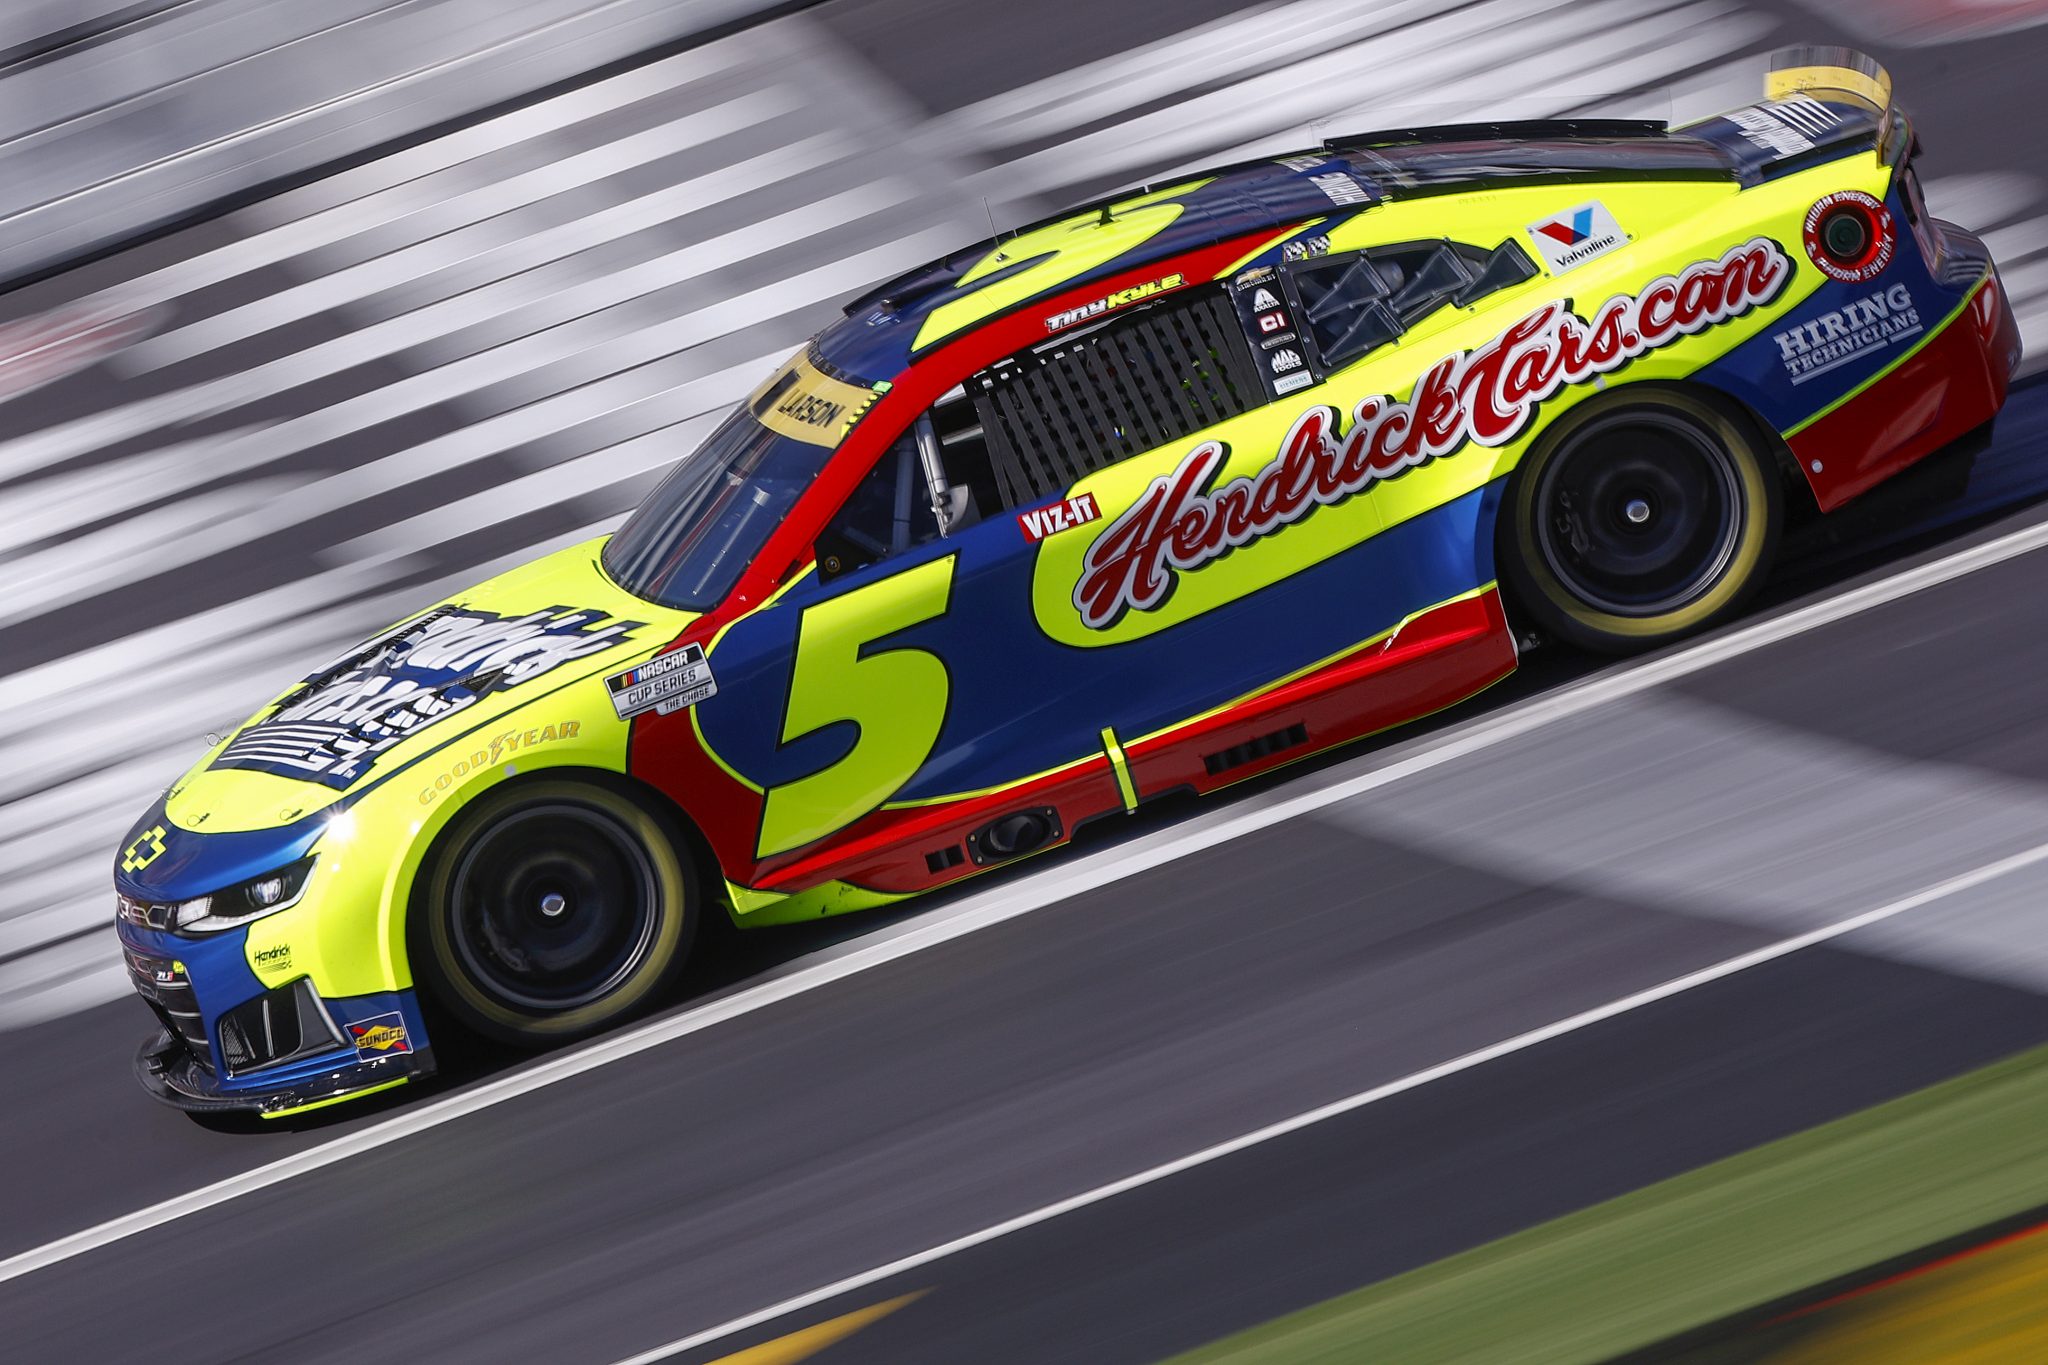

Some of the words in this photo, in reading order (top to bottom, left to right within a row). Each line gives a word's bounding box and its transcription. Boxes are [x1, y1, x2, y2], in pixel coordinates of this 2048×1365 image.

[1556, 234, 1617, 269] Valvoline
[1860, 231, 1894, 280] ENERGY
[1773, 282, 1913, 362] HIRING
[1784, 306, 1921, 377] TECHNICIANS
[1271, 348, 1301, 369] MAC
[1273, 359, 1303, 374] TOOLS
[1073, 235, 1794, 630] HendrickCars.com
[1023, 498, 1098, 540] VIZ-IT
[638, 650, 689, 681] NASCAR
[628, 686, 653, 705] CUP
[654, 669, 697, 696] SERIES
[665, 698, 682, 711] THE
[682, 687, 710, 705] CHASE
[757, 550, 955, 860] 5
[418, 720, 581, 806] GOODYEAR
[357, 1028, 405, 1049] SUNOCO
